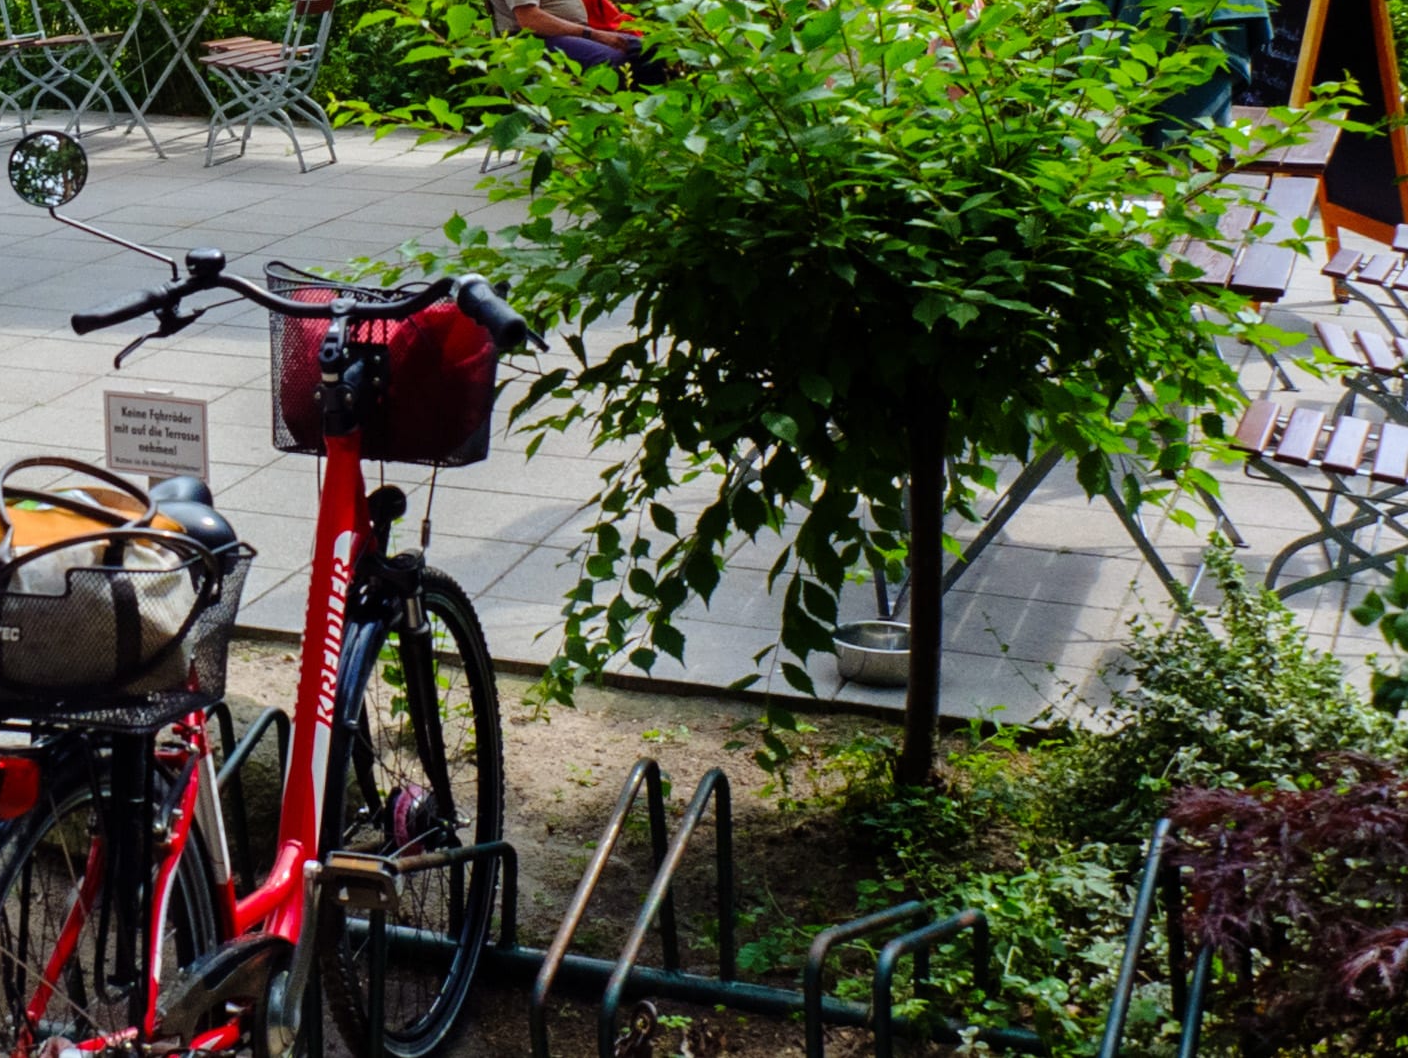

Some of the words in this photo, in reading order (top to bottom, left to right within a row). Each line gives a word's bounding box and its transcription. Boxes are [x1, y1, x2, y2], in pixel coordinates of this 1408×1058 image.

[121, 407, 146, 419] Keine
[114, 425, 129, 434] mit
[131, 424, 146, 436] auf
[148, 425, 163, 438] die
[165, 427, 200, 442] Terrasse
[316, 556, 350, 727] KREIDLER
